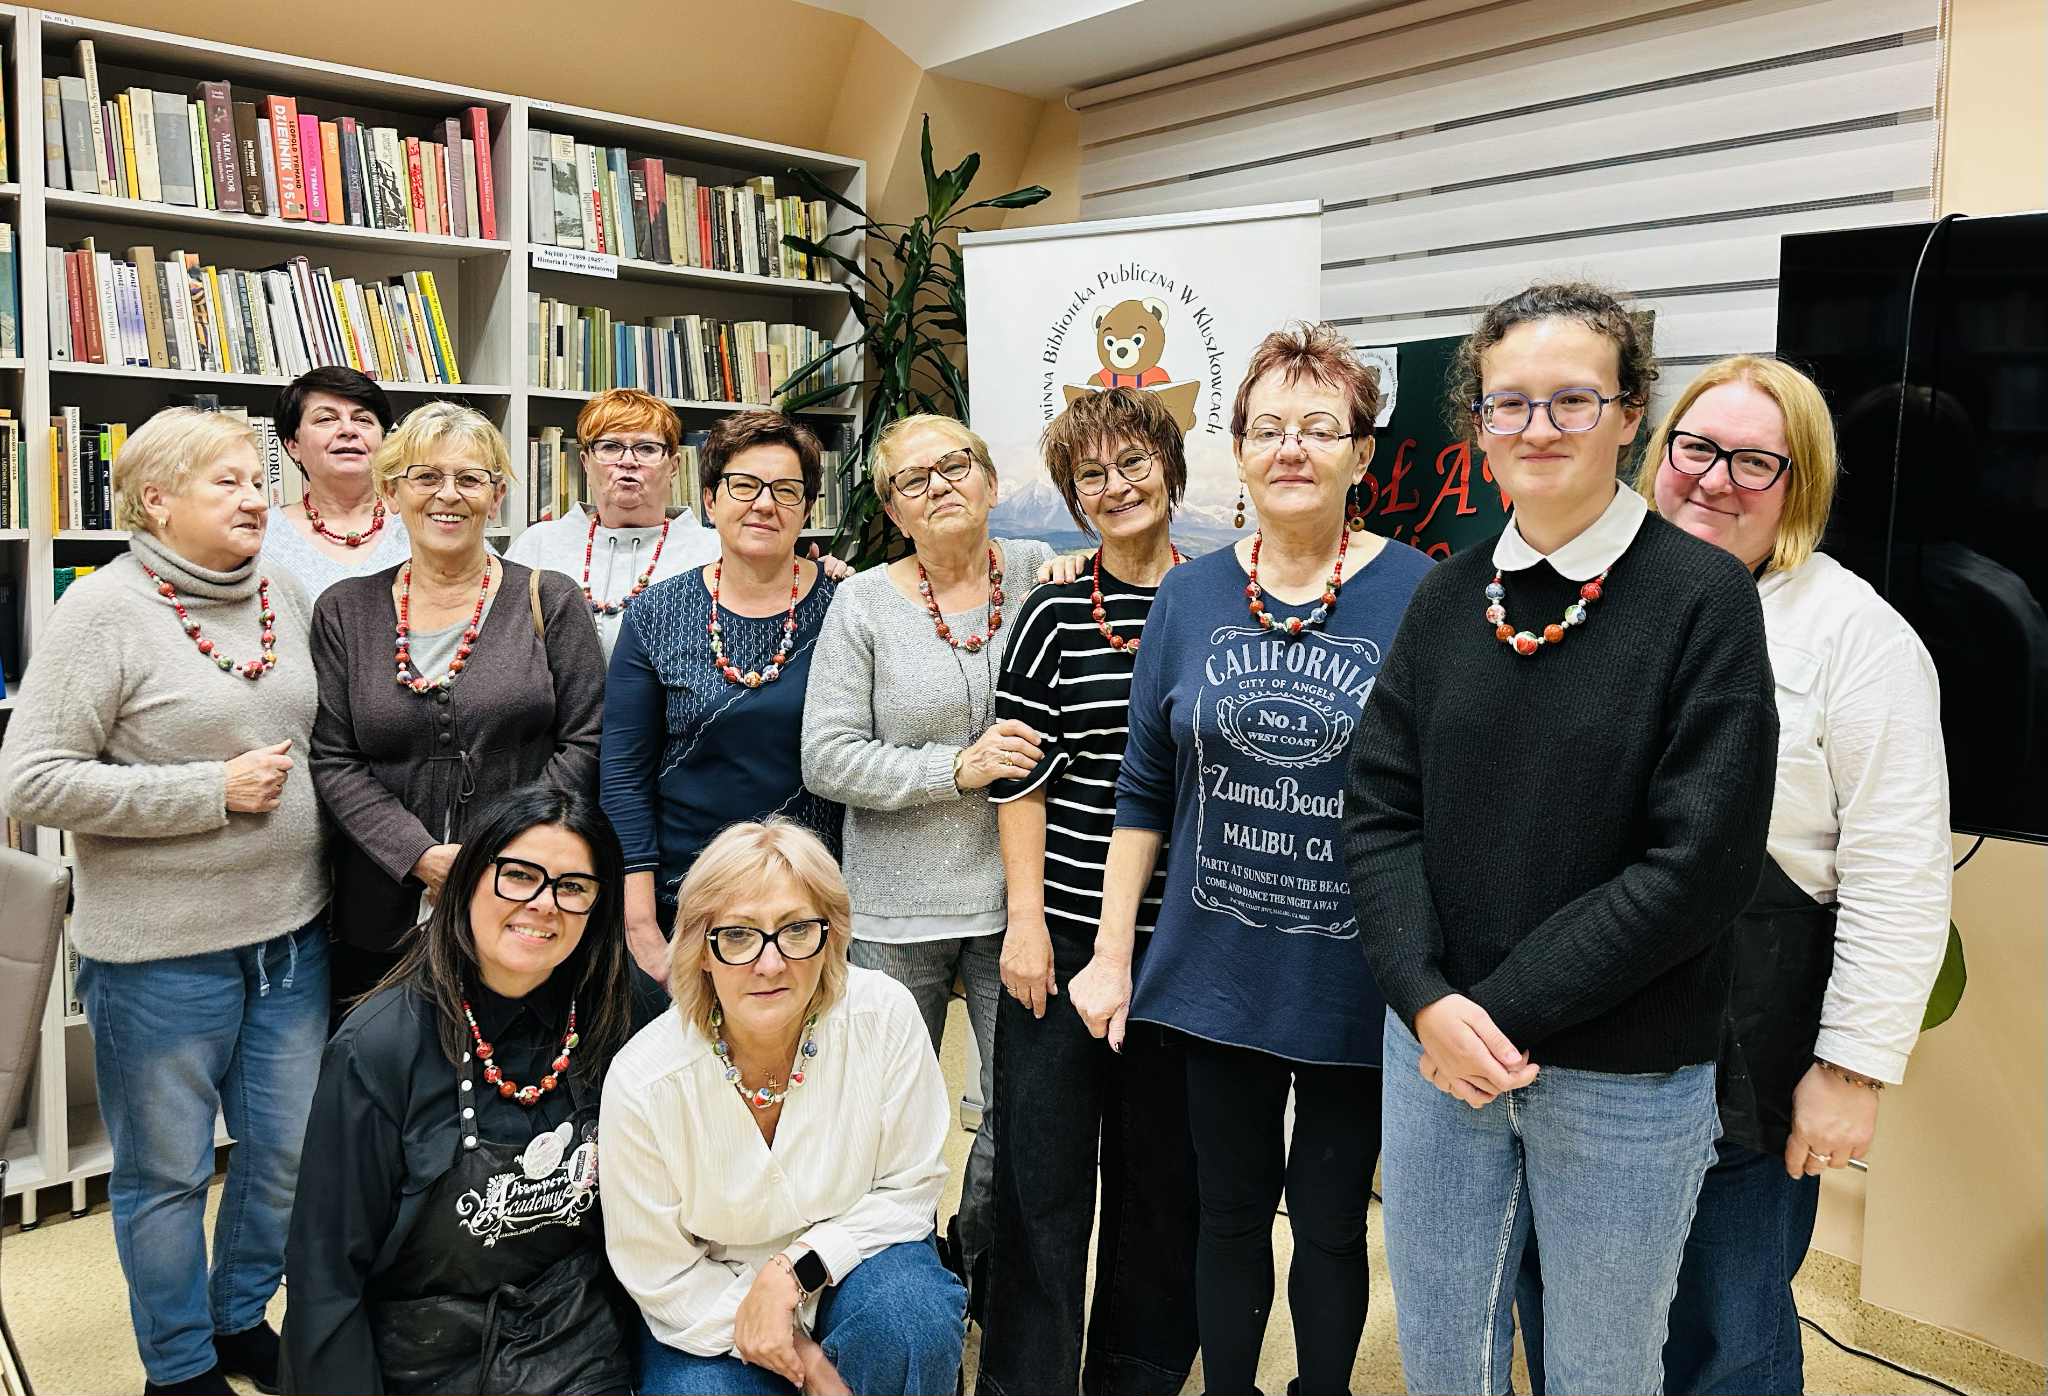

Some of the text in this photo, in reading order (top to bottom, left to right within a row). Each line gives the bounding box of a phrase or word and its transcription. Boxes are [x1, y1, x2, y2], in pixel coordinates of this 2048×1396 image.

[275, 105, 292, 171] DZIENNIK
[293, 153, 301, 189] TYRMAND
[309, 168, 319, 207] TYRMAND
[267, 424, 280, 484] HISTORIA
[1205, 640, 1377, 709] CALIFORNIA
[1239, 678, 1336, 701] CITY OF ANGELS
[1247, 731, 1318, 748] WEST COAST
[1306, 837, 1334, 862] CA
[1201, 855, 1350, 895] PARTY AT SUNSET ON THE BEAC
[1205, 876, 1339, 911] COME AND DANCE THE NIGHT AWAY
[508, 1172, 569, 1198] Stamperi
